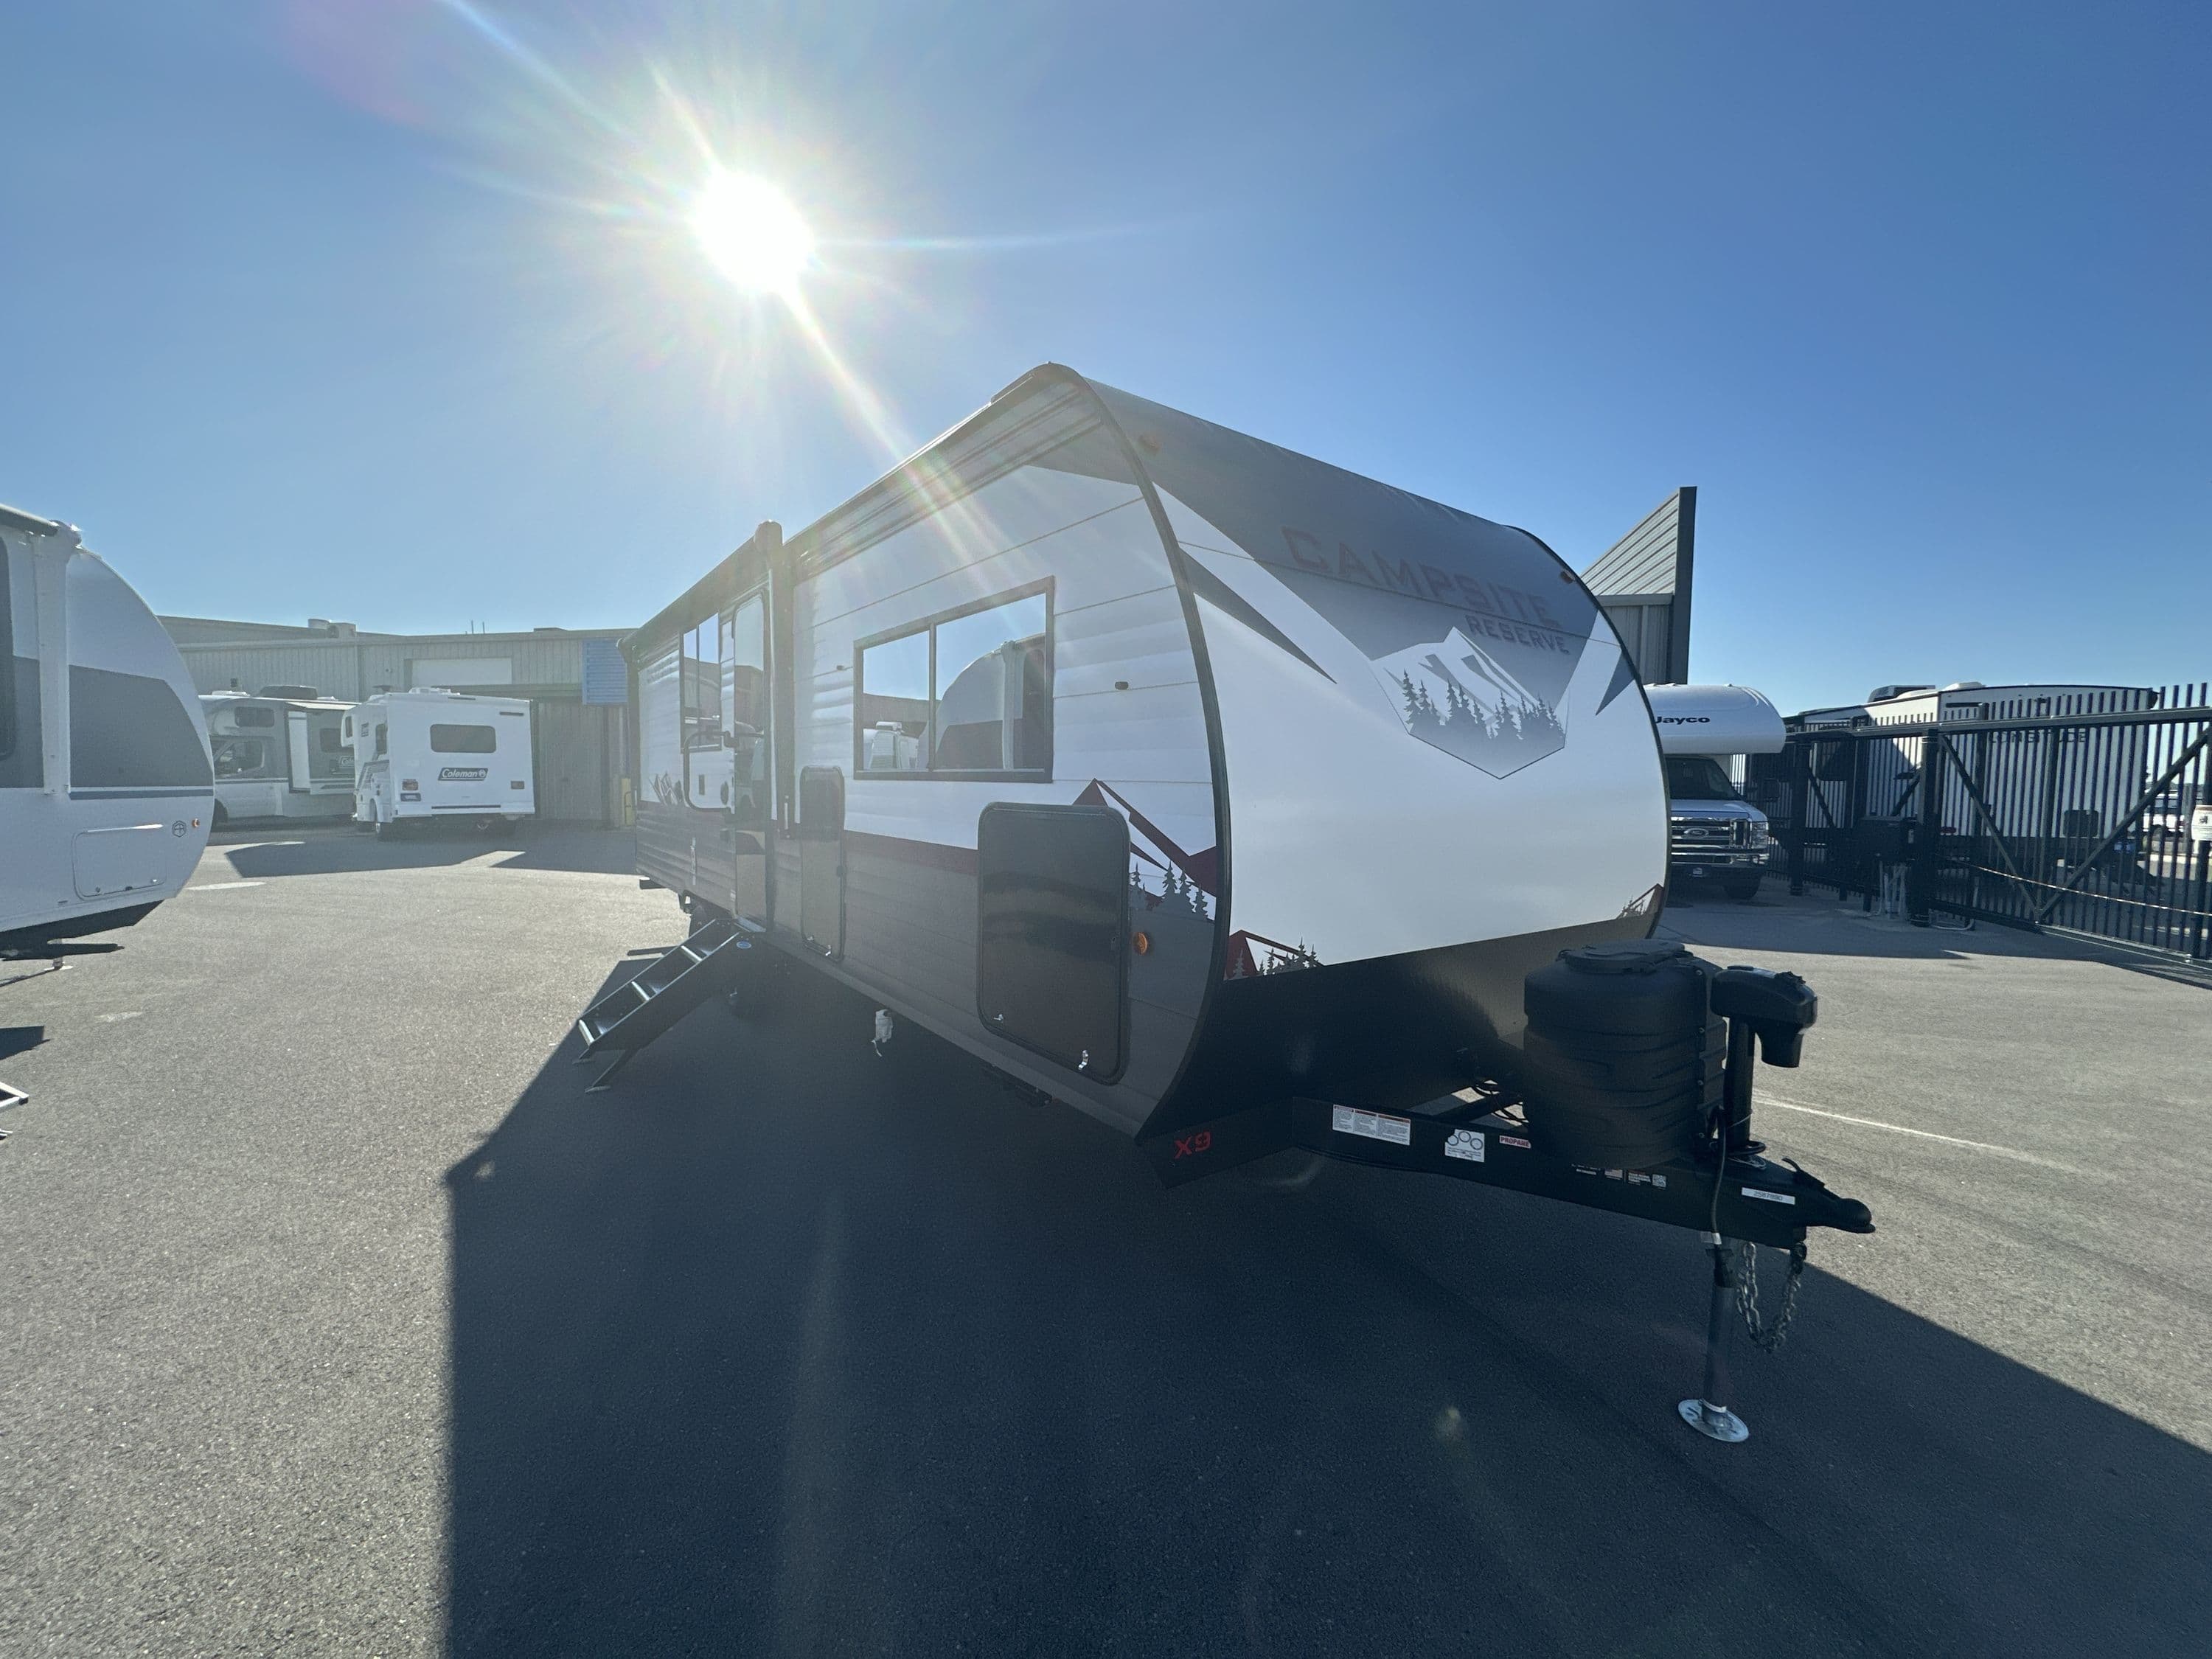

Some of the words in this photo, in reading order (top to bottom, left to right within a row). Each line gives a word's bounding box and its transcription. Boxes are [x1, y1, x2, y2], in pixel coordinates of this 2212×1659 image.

[1281, 526, 1561, 628] CAMPSITE
[1465, 614, 1571, 655] RESERVE
[1655, 716, 1711, 725] Jayco
[442, 768, 478, 778] Coleman
[1500, 1136, 1530, 1147] PROPANE
